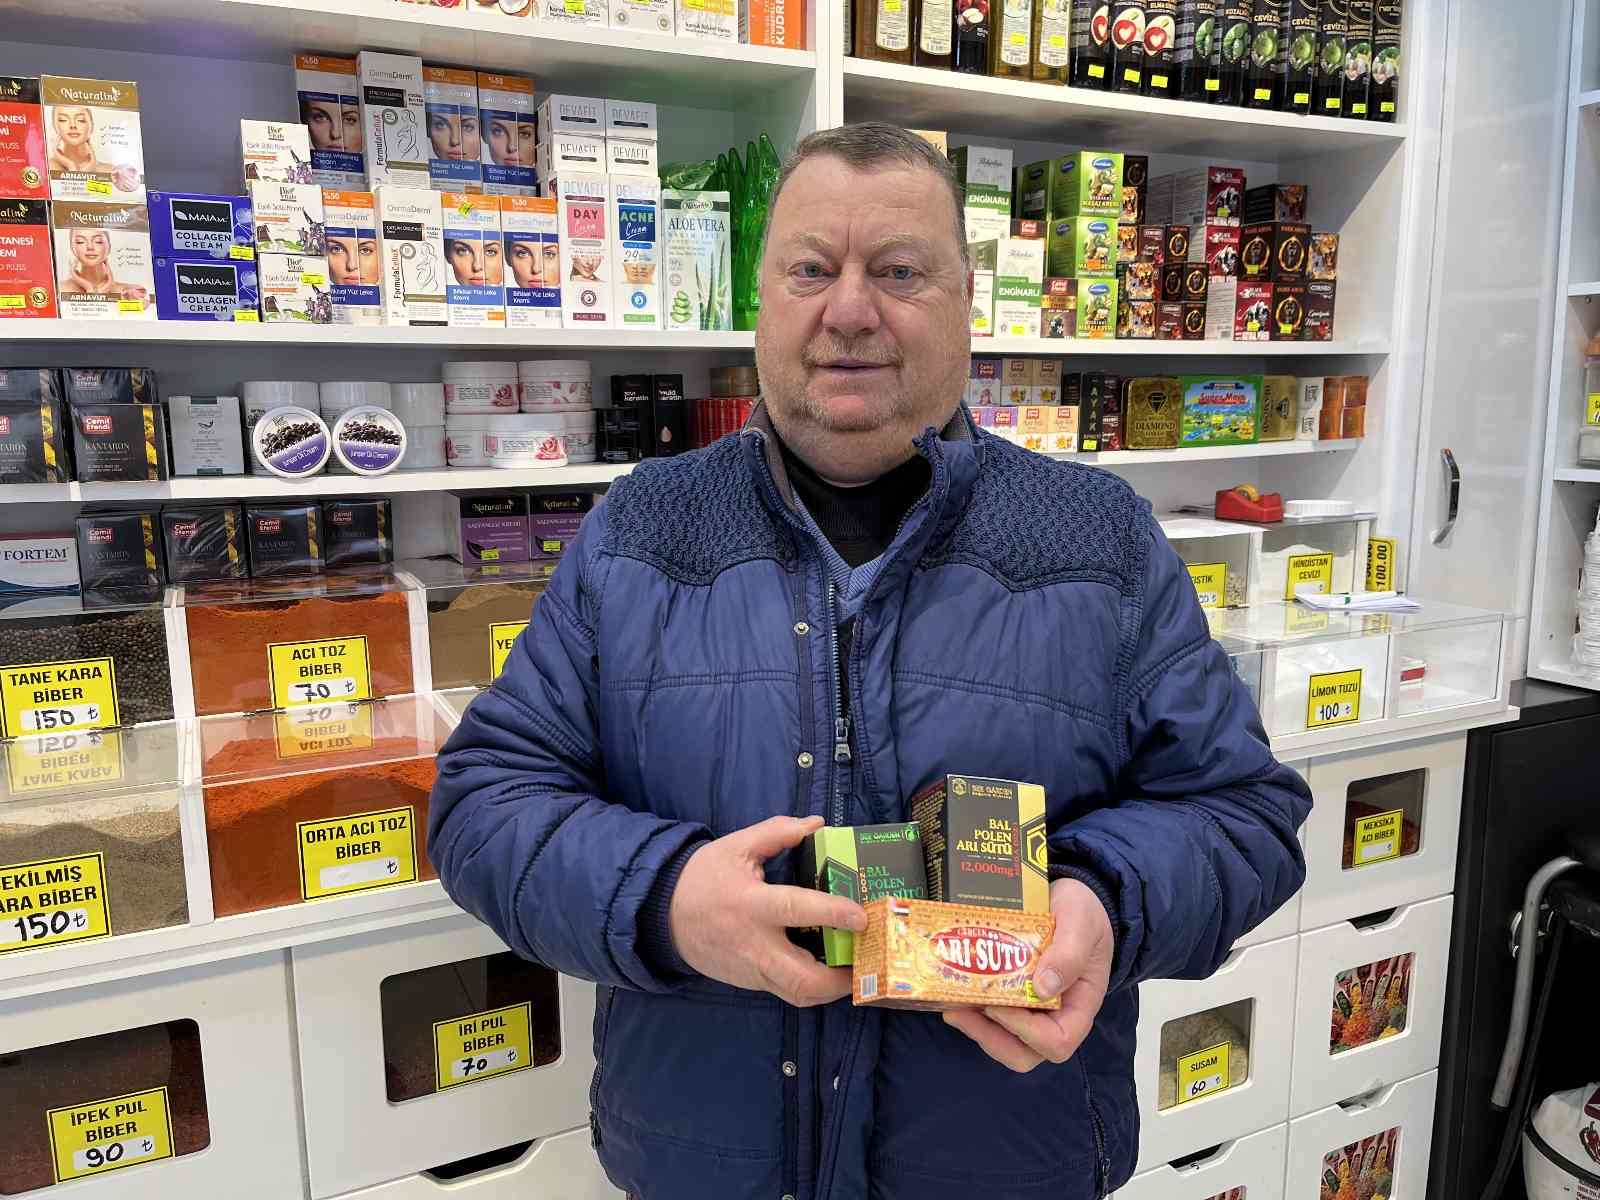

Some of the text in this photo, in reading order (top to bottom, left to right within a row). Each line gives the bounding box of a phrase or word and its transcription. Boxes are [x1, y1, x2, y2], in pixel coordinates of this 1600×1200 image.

[573, 209, 598, 220] DAY
[619, 211, 655, 223] ACNE
[668, 216, 726, 233] ALOE VERA
[175, 231, 232, 242] COLLAGEN
[184, 240, 224, 250] CREAM
[180, 295, 237, 306] COLLAGEN
[189, 303, 228, 313] CREAM
[86, 418, 110, 426] Cemil
[1134, 421, 1176, 431] DIAMOND
[89, 529, 112, 537] Cemil
[1375, 544, 1388, 588] 100.00
[291, 643, 347, 661] ACI TOZ
[495, 638, 513, 650] YE
[8, 666, 103, 687] TANE KARA
[299, 661, 343, 678] BİBER
[32, 686, 84, 704] BİBER
[295, 683, 331, 702] 70
[34, 708, 76, 730] 150
[304, 815, 408, 844] ORTA ACI TOZ
[989, 818, 1012, 831] BAL
[974, 829, 1012, 842] POLEN
[335, 839, 381, 860] BİBER
[956, 839, 1013, 856] ARI SÜTÜ
[0, 864, 83, 891] EKİLMİŞ
[866, 865, 890, 877] BAL
[867, 876, 905, 891] POLEN
[38, 885, 98, 908] BİBER
[15, 909, 71, 942] 150
[936, 936, 972, 969] ARI
[974, 932, 1029, 972] SÜTÜ
[480, 1014, 508, 1032] PUL
[463, 1032, 505, 1054] BİBER
[460, 1056, 489, 1077] 70
[1190, 1055, 1218, 1073] SUSAM
[1190, 1079, 1208, 1096] 60
[70, 1099, 148, 1127] İPEK PUL
[85, 1120, 138, 1144] BİBER
[85, 1141, 125, 1168] 90
